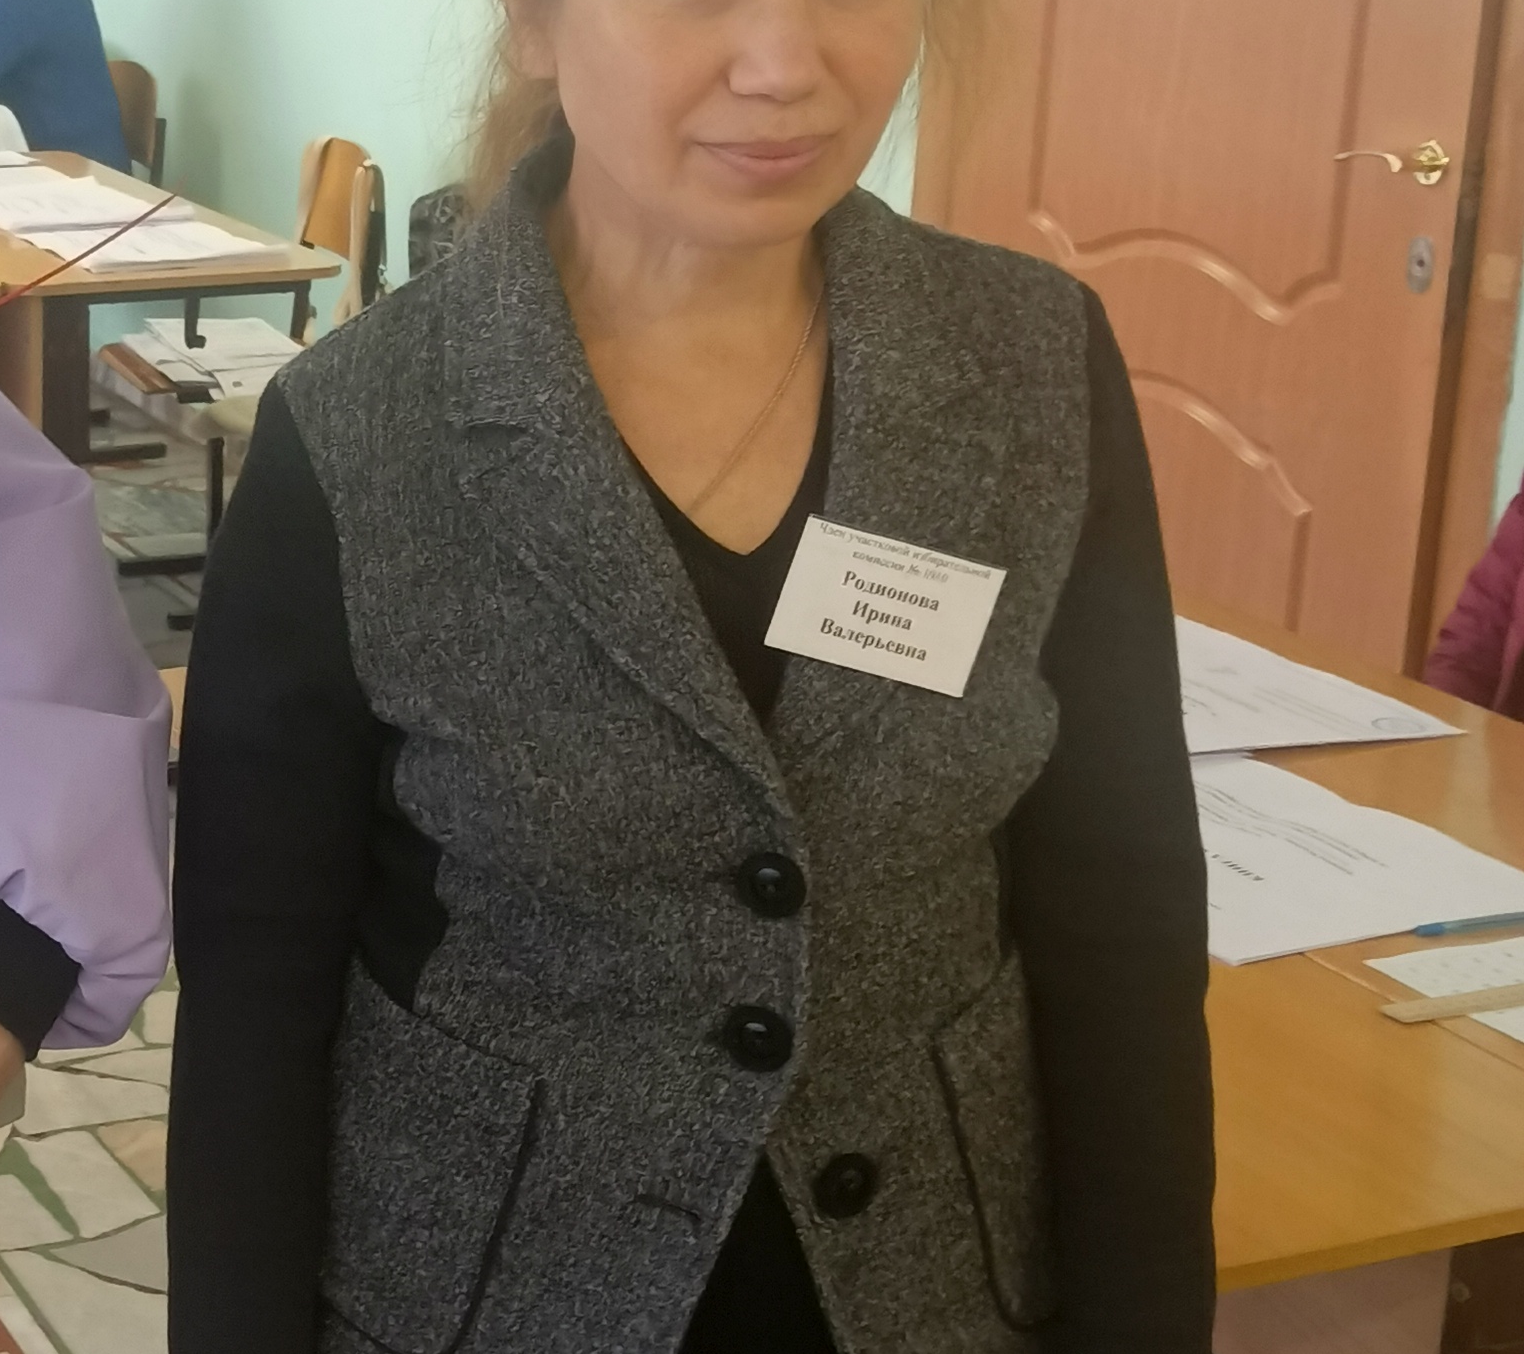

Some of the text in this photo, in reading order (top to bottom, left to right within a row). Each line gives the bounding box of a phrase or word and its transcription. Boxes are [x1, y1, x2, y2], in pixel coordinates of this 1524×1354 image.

[819, 521, 847, 540] Член
[848, 533, 911, 557] участковой
[841, 570, 940, 612] Родионова
[852, 599, 913, 631] Ирина
[820, 617, 928, 662] Валерьевна
